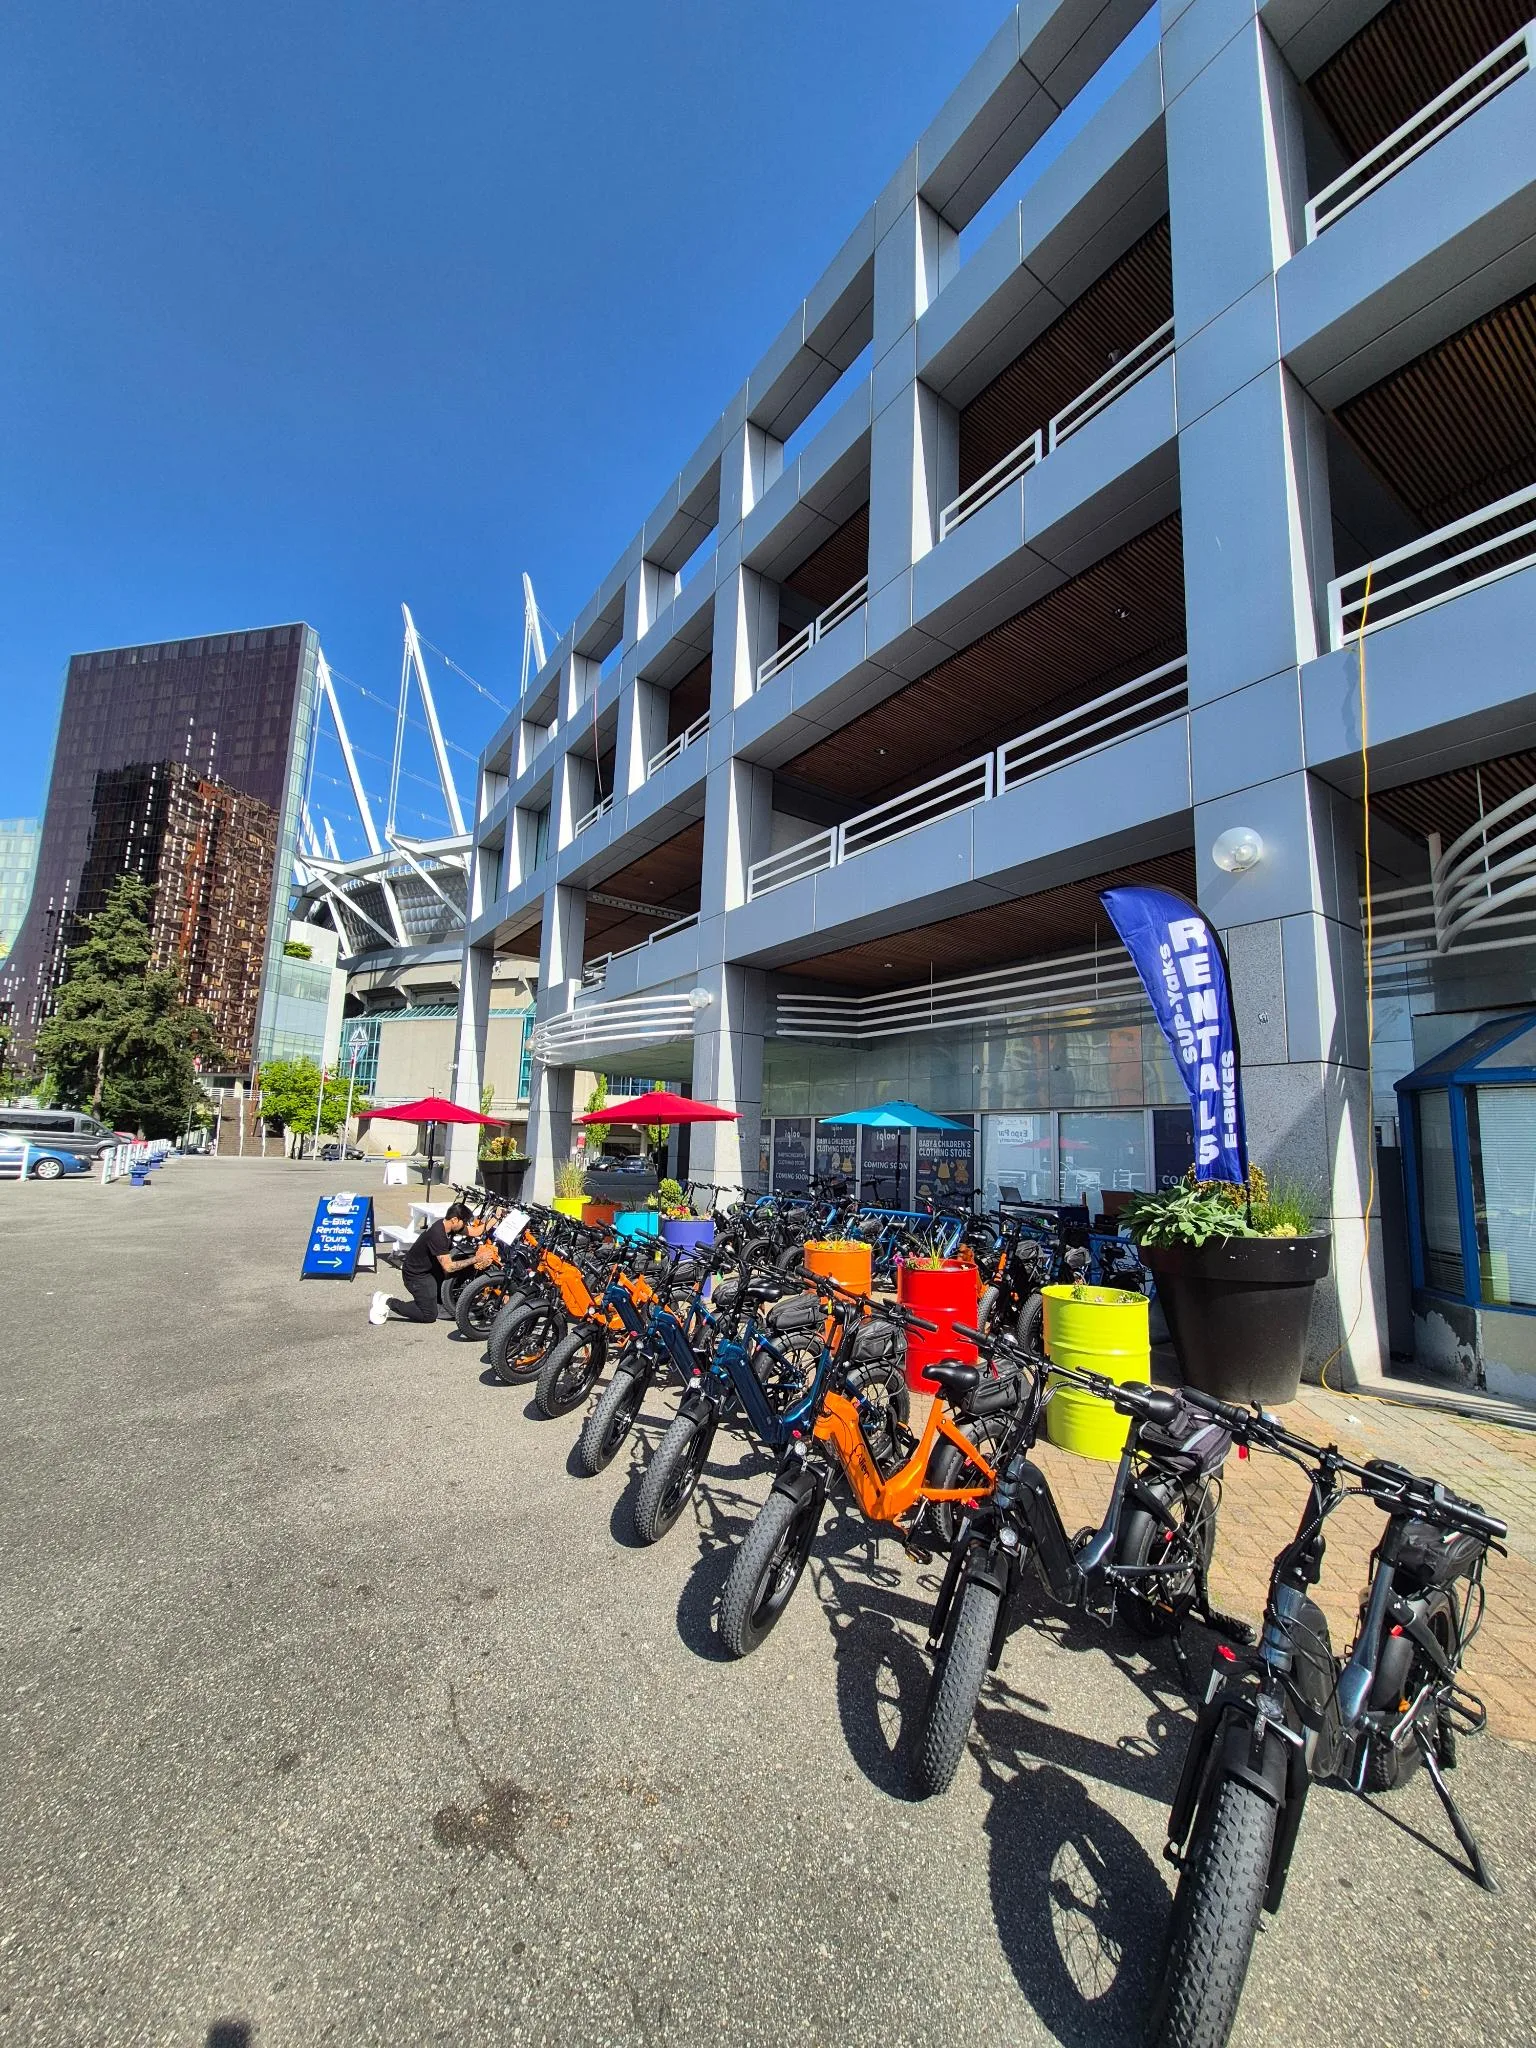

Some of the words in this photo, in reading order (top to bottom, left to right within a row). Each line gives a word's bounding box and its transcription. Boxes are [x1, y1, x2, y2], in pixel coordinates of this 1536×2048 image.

[1167, 917, 1220, 1166] RENTALS
[1221, 1049, 1238, 1150] E-BIKES
[876, 1128, 896, 1150] igloo
[937, 1140, 971, 1148] CHILDREN'S
[918, 1148, 948, 1157] CLOTHING
[950, 1149, 972, 1158] STORE
[863, 1160, 888, 1169] COMING
[322, 1218, 353, 1226] E-Bike
[321, 1235, 347, 1243] Tours
[313, 1243, 321, 1252] &
[323, 1243, 351, 1252] Sales
